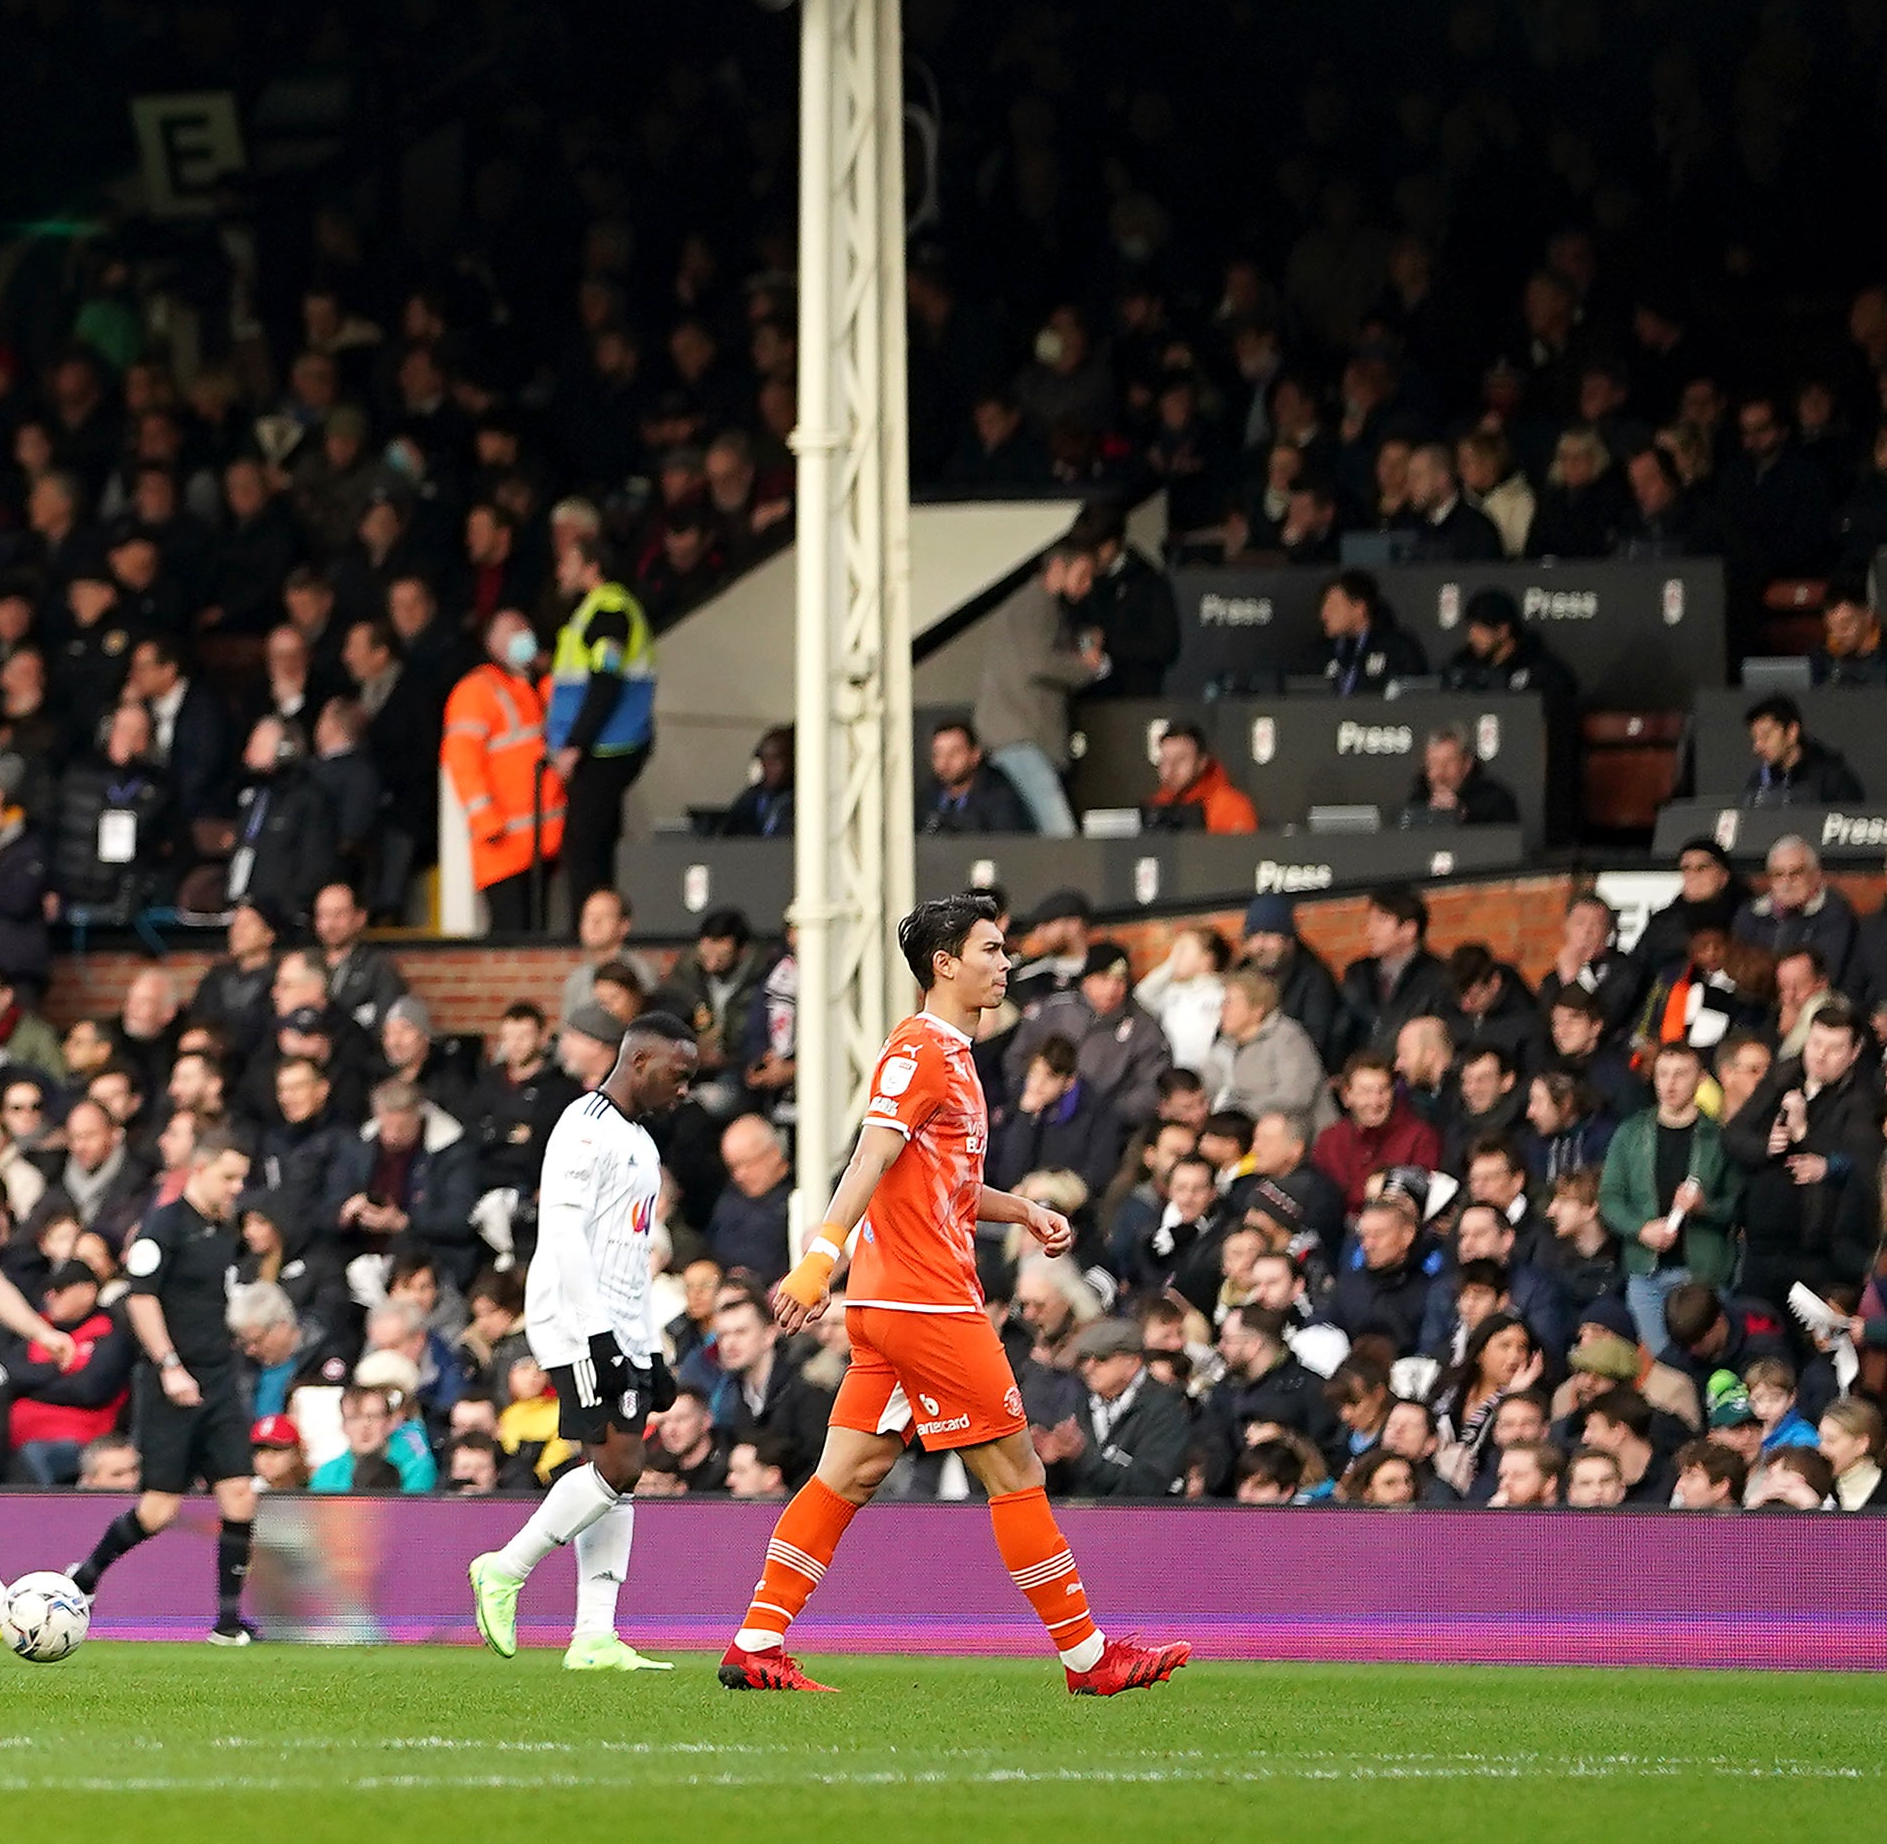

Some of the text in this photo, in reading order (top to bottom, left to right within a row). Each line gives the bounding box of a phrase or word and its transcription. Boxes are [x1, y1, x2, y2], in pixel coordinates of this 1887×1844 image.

[160, 116, 217, 195] E
[1201, 594, 1272, 626] Press
[1524, 587, 1597, 619] Press
[1337, 721, 1413, 754] Press
[1821, 812, 1887, 846] Pres
[1255, 860, 1332, 894] Press
